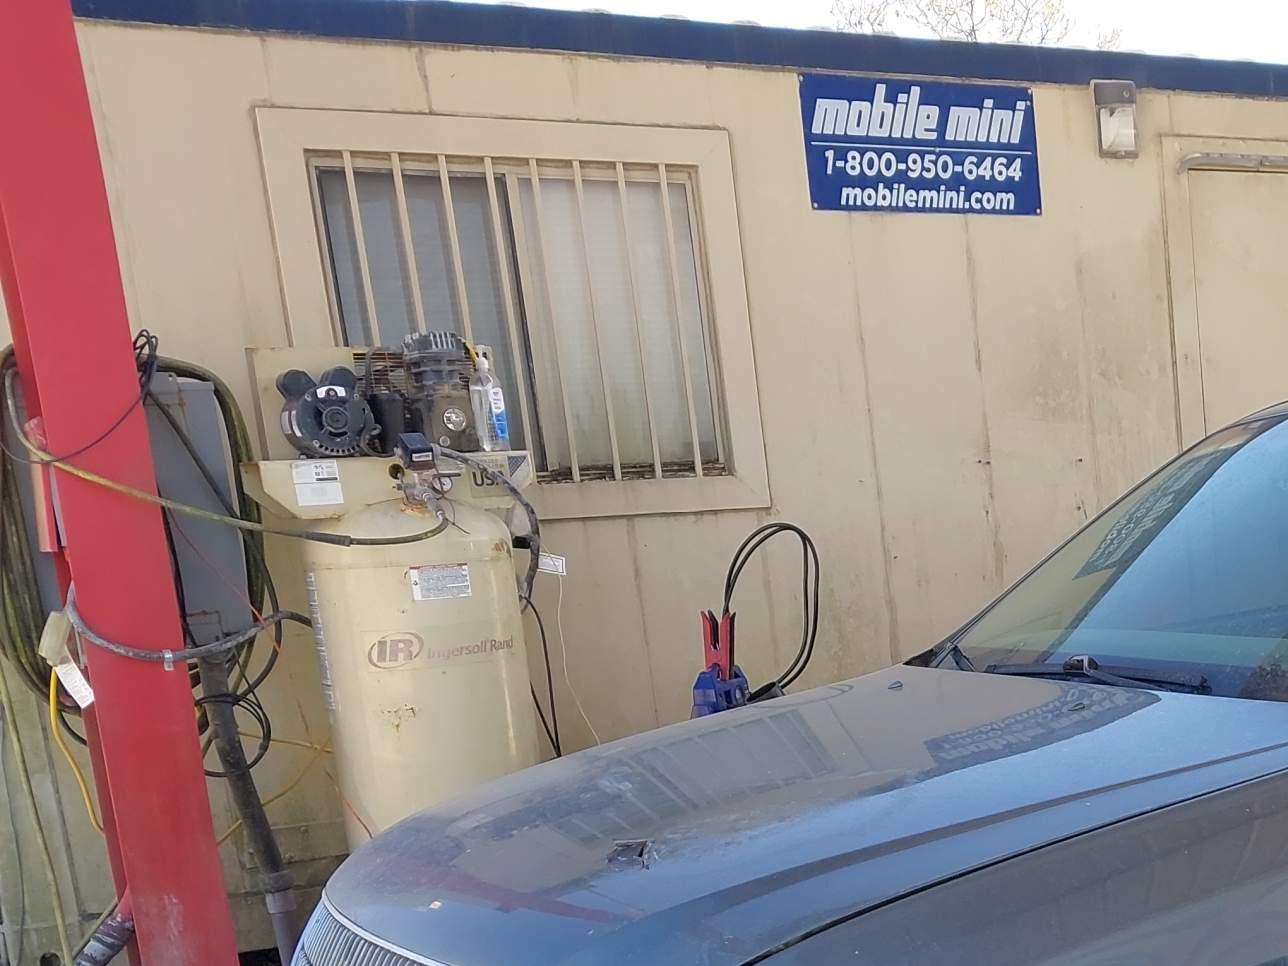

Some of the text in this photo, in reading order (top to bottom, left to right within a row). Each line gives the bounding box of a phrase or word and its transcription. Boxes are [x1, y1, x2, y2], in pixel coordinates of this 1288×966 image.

[811, 83, 1025, 144] mobile mini
[824, 149, 1022, 182] 1-800-950-6464
[840, 183, 1015, 210] mobilemini.com
[377, 638, 414, 663] IR
[490, 635, 513, 651] Rand
